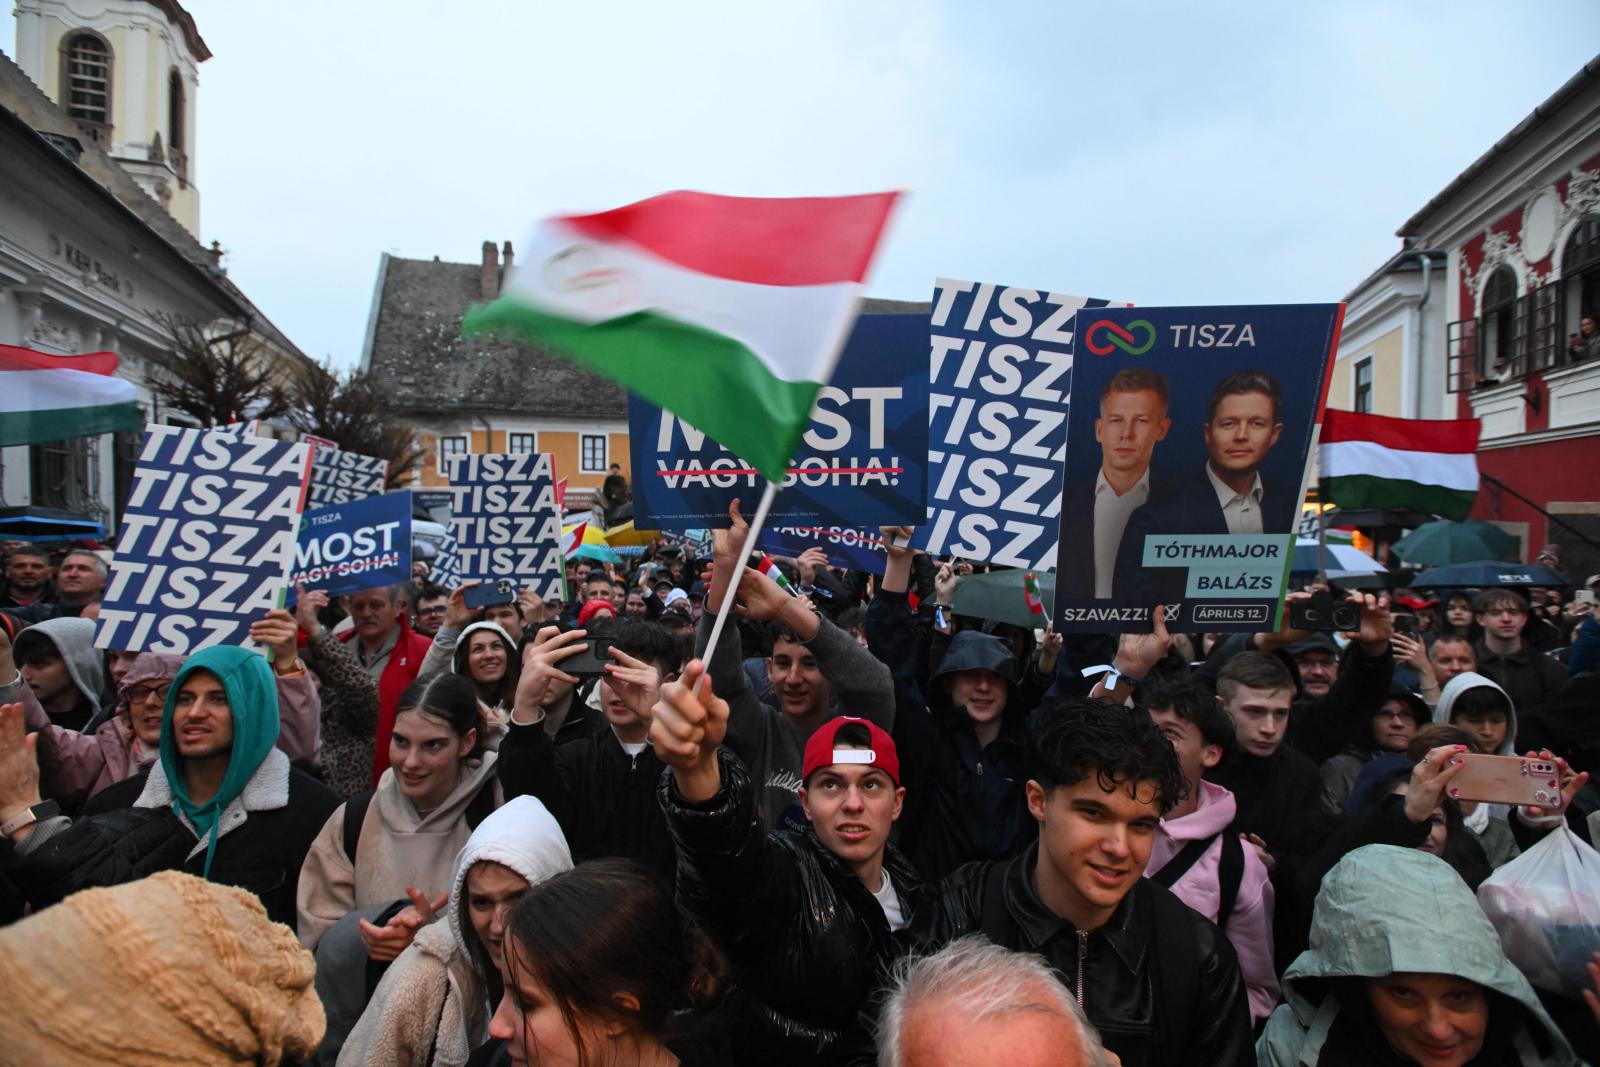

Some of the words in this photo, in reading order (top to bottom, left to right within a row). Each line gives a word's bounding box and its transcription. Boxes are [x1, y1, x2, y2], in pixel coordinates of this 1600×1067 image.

[931, 277, 1089, 344] TISZ
[1170, 323, 1256, 348] TISZA
[930, 334, 1074, 404] TISZ
[930, 392, 1066, 462] TISZ
[139, 423, 309, 480] TISZA
[318, 446, 390, 476] TISZA
[314, 464, 385, 495] TISZA
[447, 453, 553, 482] TISZA
[128, 467, 302, 524] TISZA
[451, 484, 556, 514] TISZA
[312, 512, 342, 526] TISZA
[454, 516, 559, 545] TISZA
[115, 513, 293, 570] TISZA
[296, 521, 400, 568] MOST
[1154, 541, 1279, 559] TÓTHMAJOR
[288, 564, 335, 588] VAGY
[338, 551, 399, 577] SOHA!
[458, 548, 562, 575] TISZA
[104, 560, 282, 615] TISZA
[1197, 572, 1273, 590] BALÁZS
[1064, 608, 1149, 622] SZAVAZZ!
[1199, 606, 1244, 619] ÁPRILIS
[1247, 610, 1262, 619] 12.
